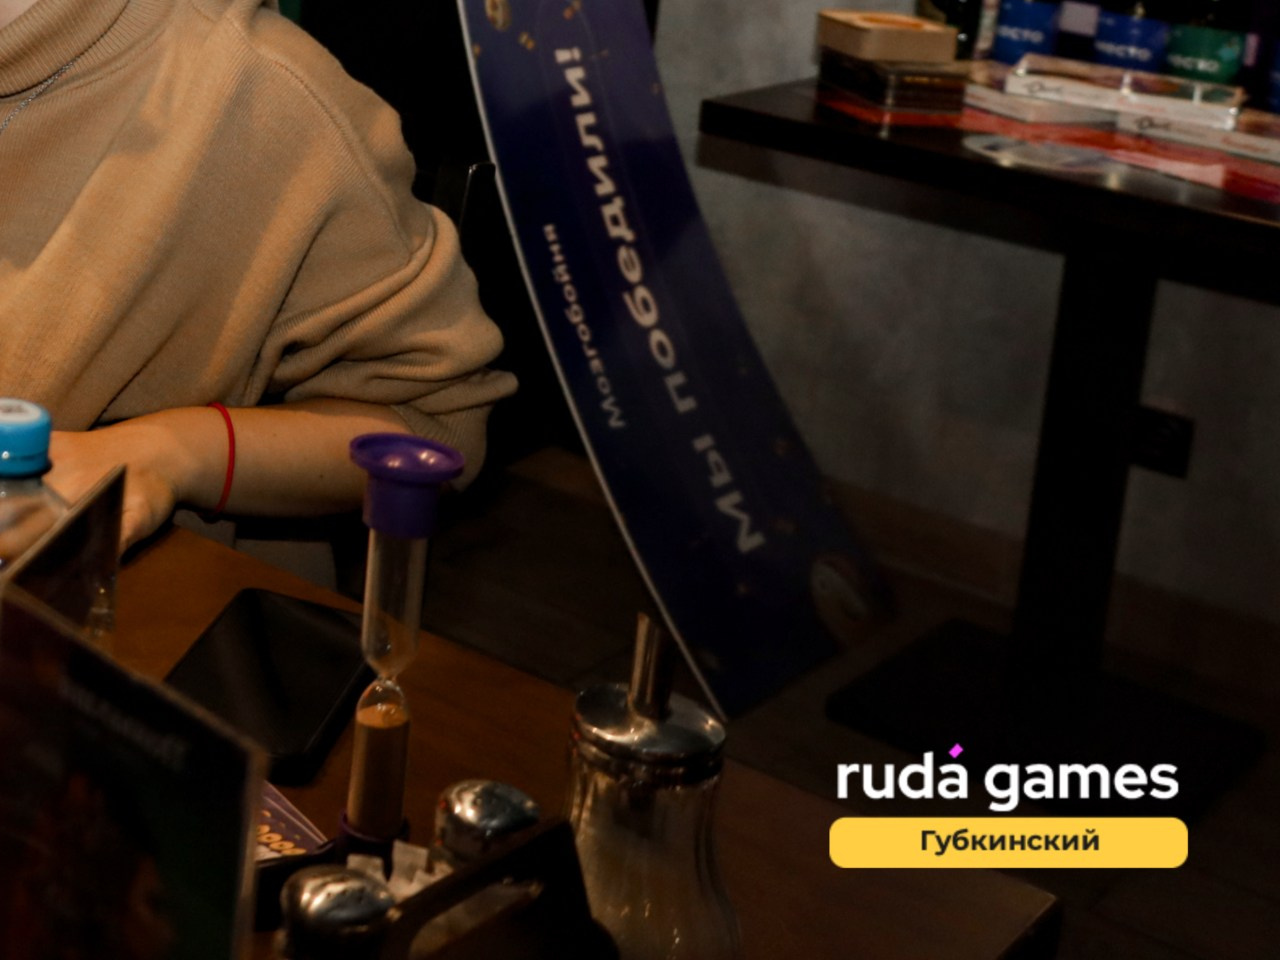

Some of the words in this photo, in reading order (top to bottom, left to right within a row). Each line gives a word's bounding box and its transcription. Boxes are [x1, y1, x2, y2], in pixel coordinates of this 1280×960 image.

[543, 223, 626, 431] Мозгобойня
[553, 45, 698, 416] победили!
[690, 431, 769, 556] Мы
